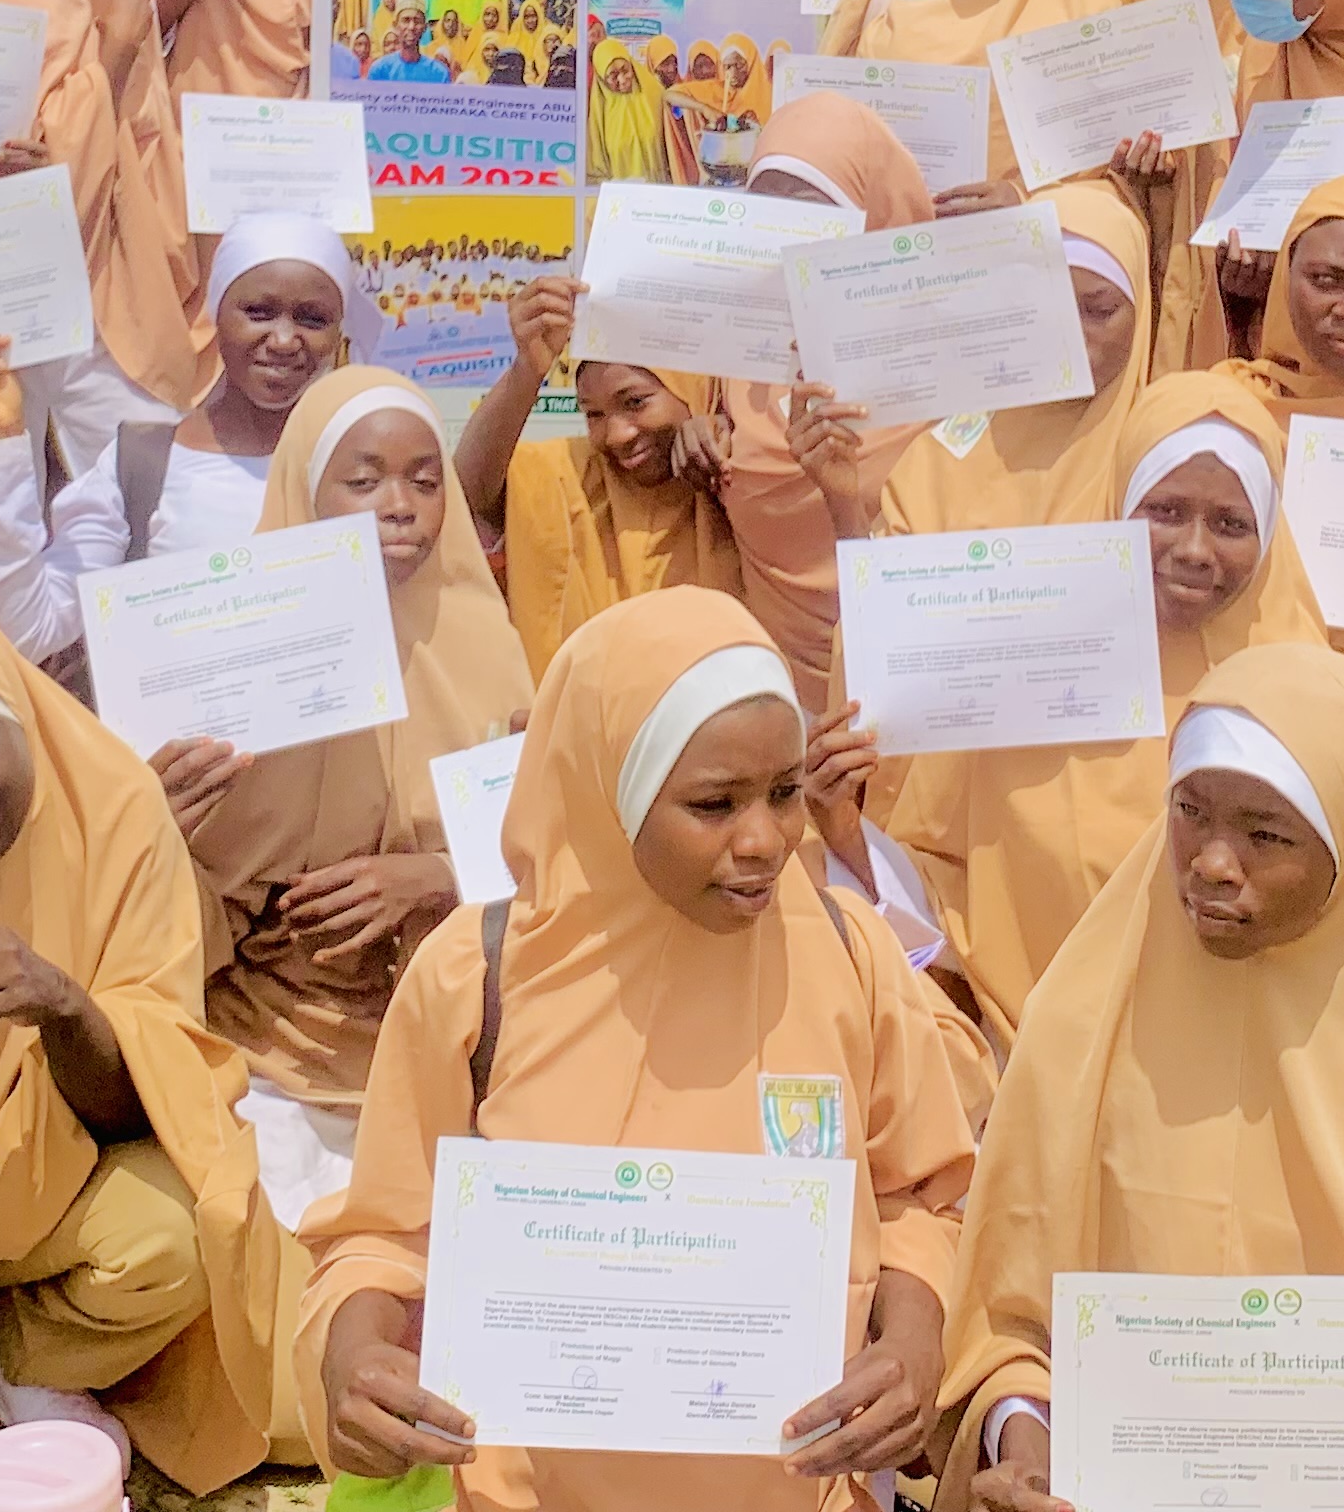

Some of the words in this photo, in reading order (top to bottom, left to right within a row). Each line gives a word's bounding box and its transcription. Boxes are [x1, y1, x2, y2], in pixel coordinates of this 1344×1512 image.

[330, 92, 380, 103] Society
[385, 94, 397, 103] of
[401, 94, 463, 106] Chemical
[468, 98, 536, 111] Engineers
[542, 103, 572, 113] ABU
[381, 105, 410, 114] with
[415, 106, 486, 118] IDANRAKA
[491, 110, 527, 121] CARE
[494, 1183, 529, 1199] Nigerian
[531, 1186, 558, 1200] Society
[560, 1188, 569, 1197] of
[571, 1188, 607, 1201] Chemical
[609, 1191, 648, 1204] Engineers
[523, 1220, 606, 1243] Certificate
[610, 1226, 627, 1244] of
[631, 1227, 737, 1252] Participation
[1115, 1314, 1152, 1329] Nigerian
[1154, 1316, 1183, 1329] Society
[1185, 1317, 1194, 1327] of
[1196, 1317, 1233, 1329] Chemical
[1236, 1319, 1277, 1331] Engineers
[1148, 1349, 1234, 1368] Certificate
[1240, 1351, 1257, 1369] of
